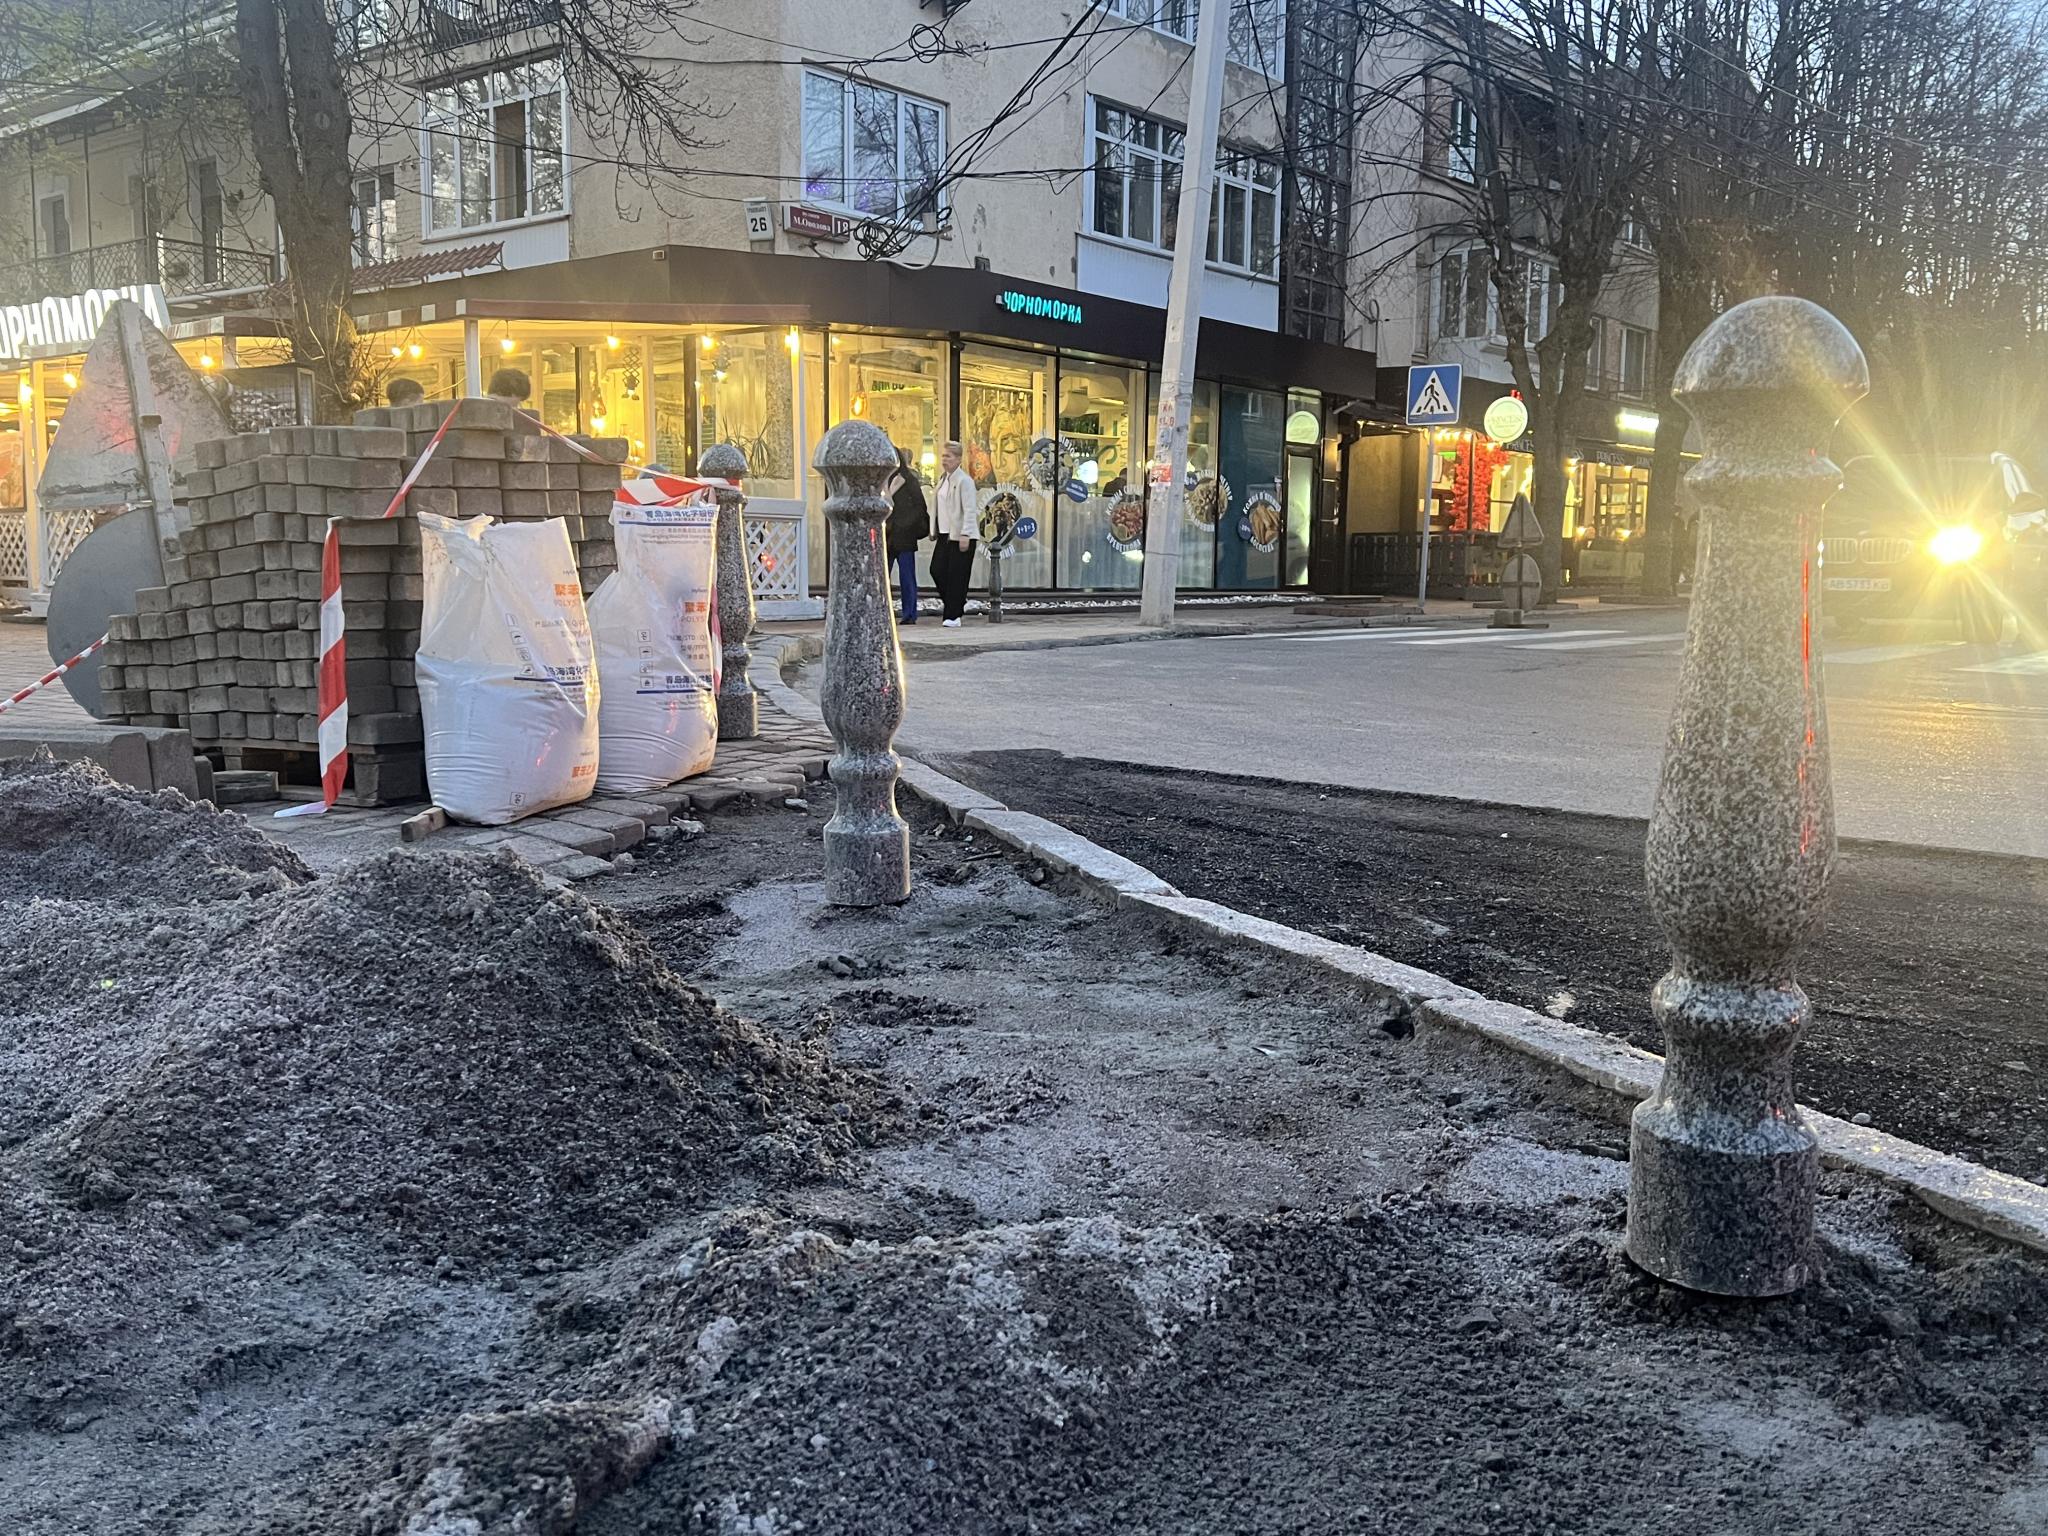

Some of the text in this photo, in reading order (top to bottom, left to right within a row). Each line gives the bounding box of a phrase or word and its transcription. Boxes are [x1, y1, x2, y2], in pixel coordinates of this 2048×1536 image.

[750, 217, 768, 232] 26
[837, 220, 849, 236] 18
[1004, 290, 1082, 324] ЧОРНОМОРКА
[1017, 522, 1036, 535] 1+1=3
